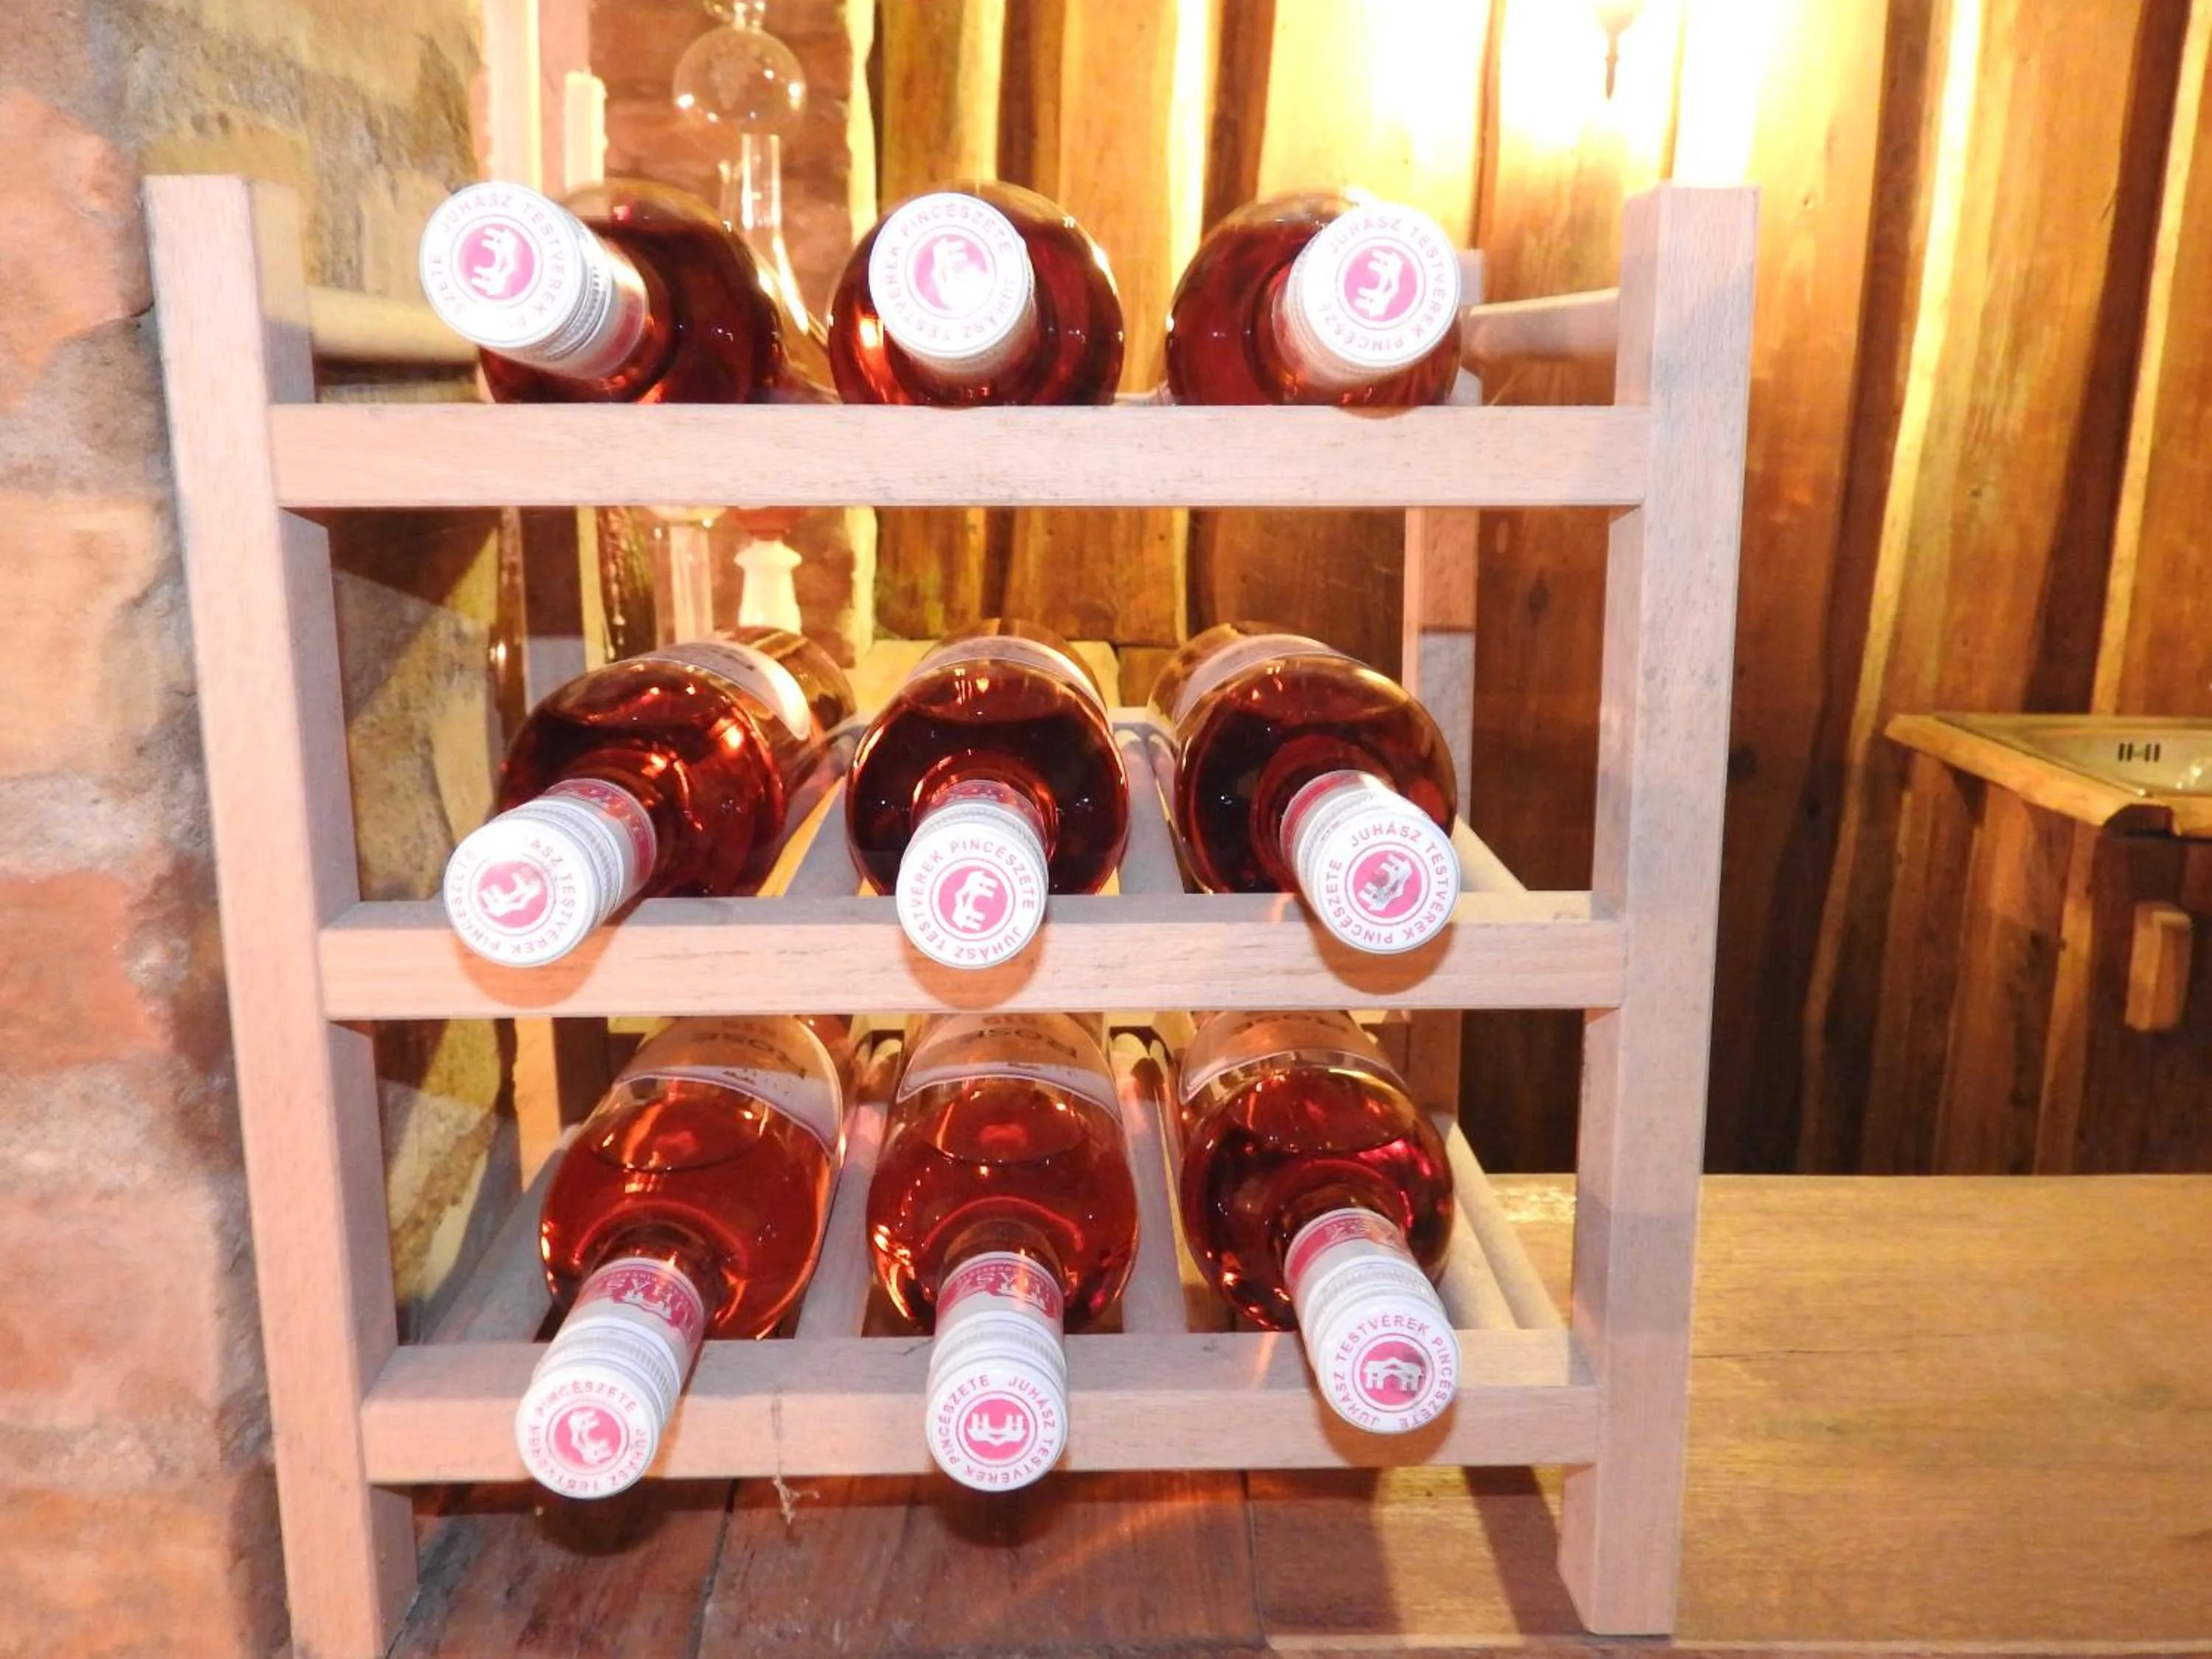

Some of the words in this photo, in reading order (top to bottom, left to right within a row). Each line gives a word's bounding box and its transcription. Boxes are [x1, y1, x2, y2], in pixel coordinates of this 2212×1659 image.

[1351, 820, 1422, 848] JUHÁSZ
[910, 849, 946, 951] TESTVÉREK
[949, 838, 1035, 910] PINCÉSZETE
[1325, 858, 1394, 945] PINCÉSZETE
[1402, 841, 1450, 941] TESTVÉREK
[953, 925, 1022, 961] JUHÁSZ
[1335, 1312, 1430, 1362] TESTVÉREK
[1007, 1376, 1056, 1429] JUHÁSZ
[1333, 1370, 1380, 1425] JUHÁSZ
[1398, 1336, 1453, 1428] PINCÉSZETE
